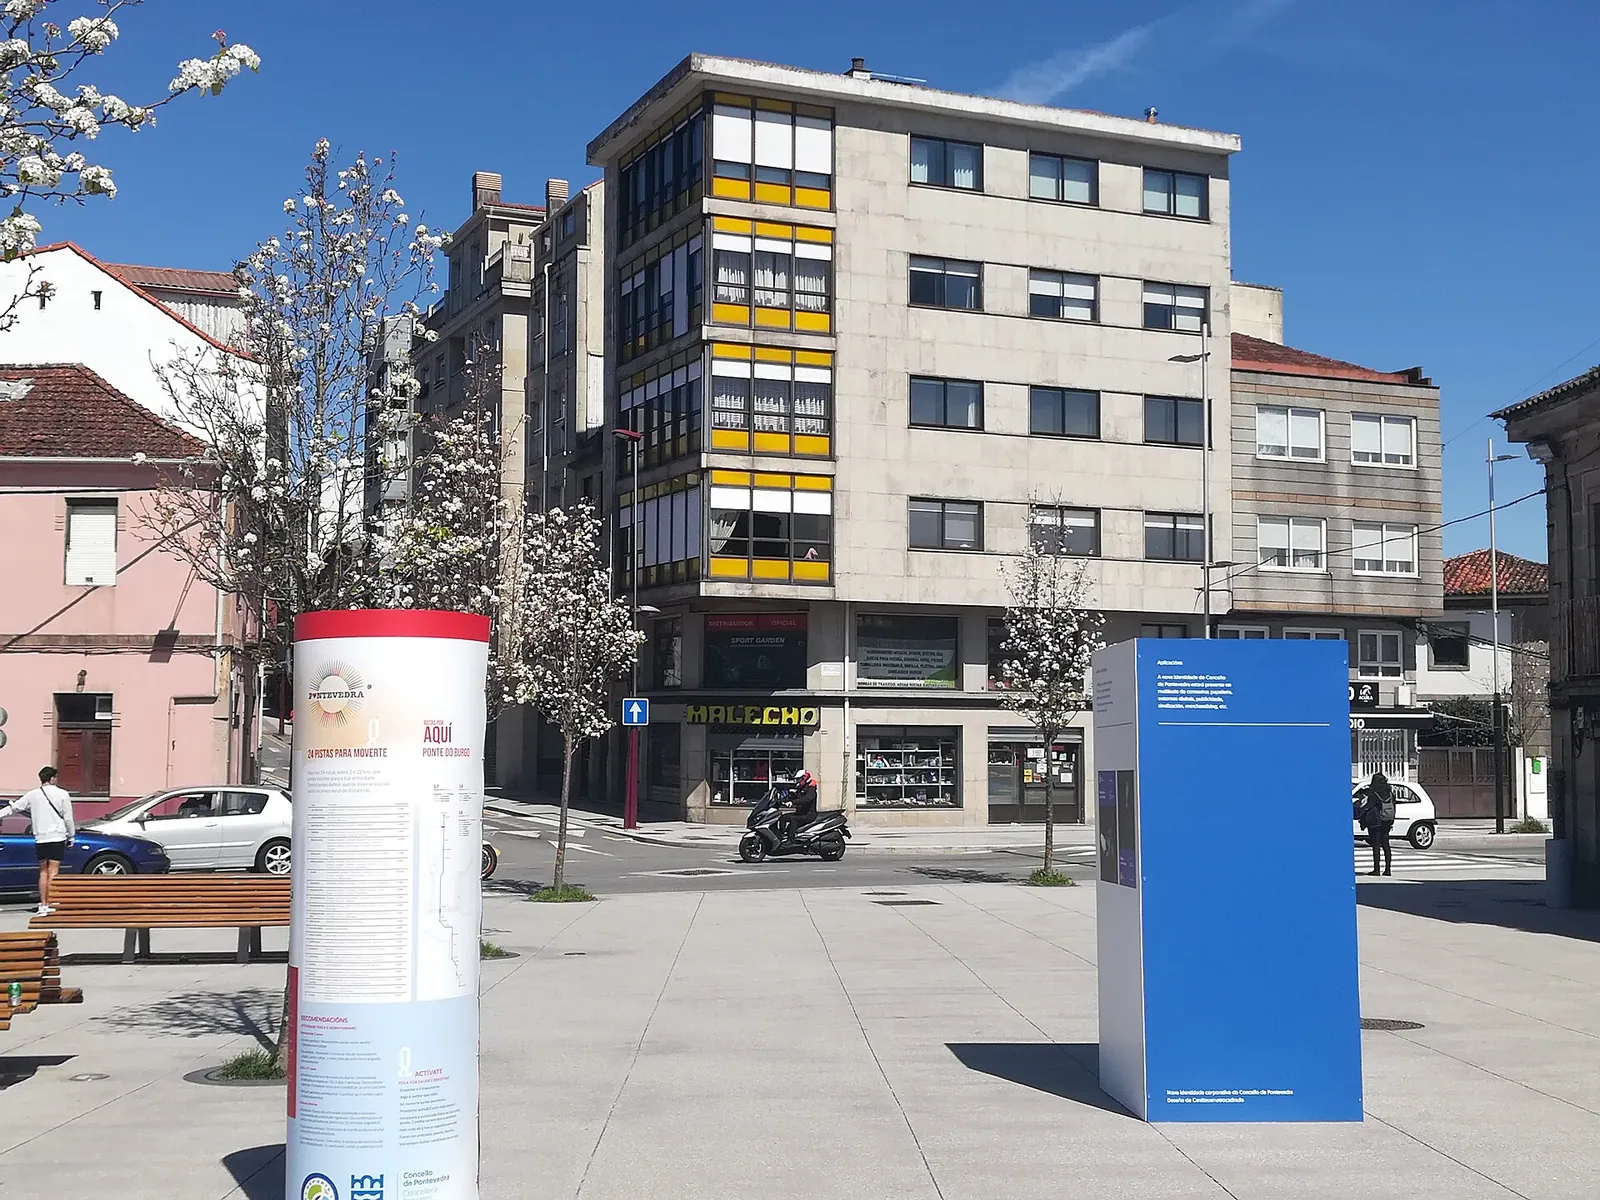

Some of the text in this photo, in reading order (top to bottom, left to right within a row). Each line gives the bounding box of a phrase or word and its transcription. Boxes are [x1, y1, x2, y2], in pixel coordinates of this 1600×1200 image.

[686, 705, 819, 726] MALECHO
[423, 722, 452, 744] AQUÍ
[308, 748, 388, 759] 24 PISTAS PARA MOVERTE
[423, 747, 470, 757] PONTE DO BURGO
[301, 1015, 348, 1024] RECOMENDACIÓNS
[415, 1069, 443, 1077] ACTÍVATE
[403, 1170, 433, 1179] Concello
[414, 1175, 449, 1186] Pontevedra
